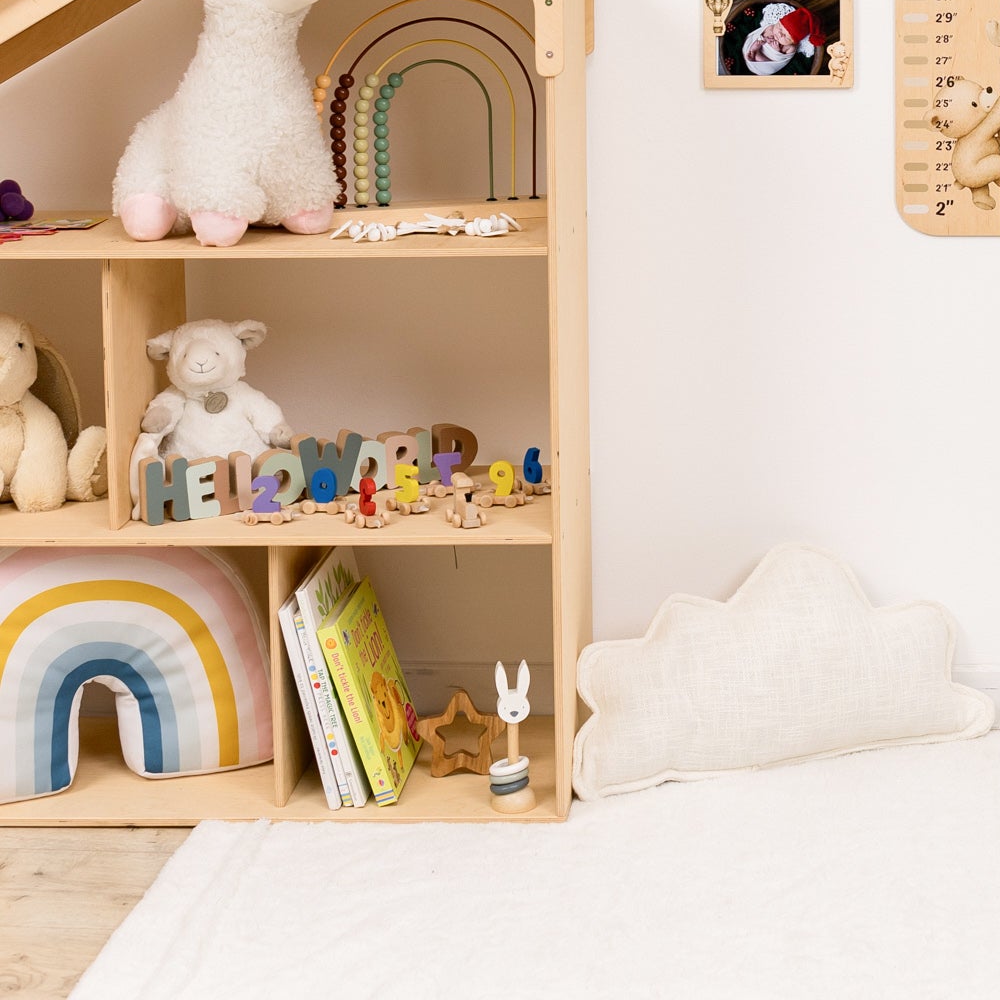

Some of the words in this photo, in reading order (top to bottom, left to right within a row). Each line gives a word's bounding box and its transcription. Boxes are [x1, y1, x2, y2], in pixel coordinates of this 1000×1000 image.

[935, 12, 957, 23] 2'9"
[935, 76, 960, 88] 2'6"
[935, 140, 957, 151] 2'3"
[935, 200, 954, 216] 2"
[142, 449, 306, 526] HELLO
[294, 423, 478, 497] WORLD
[395, 463, 419, 503] 5
[489, 460, 515, 496] 9
[251, 475, 281, 513] 2
[318, 669, 326, 680] TAP
[330, 714, 338, 728] TREE
[332, 653, 344, 671] Don't
[338, 673, 350, 692] tickle
[346, 694, 355, 706] the
[351, 707, 362, 723] Lion!
